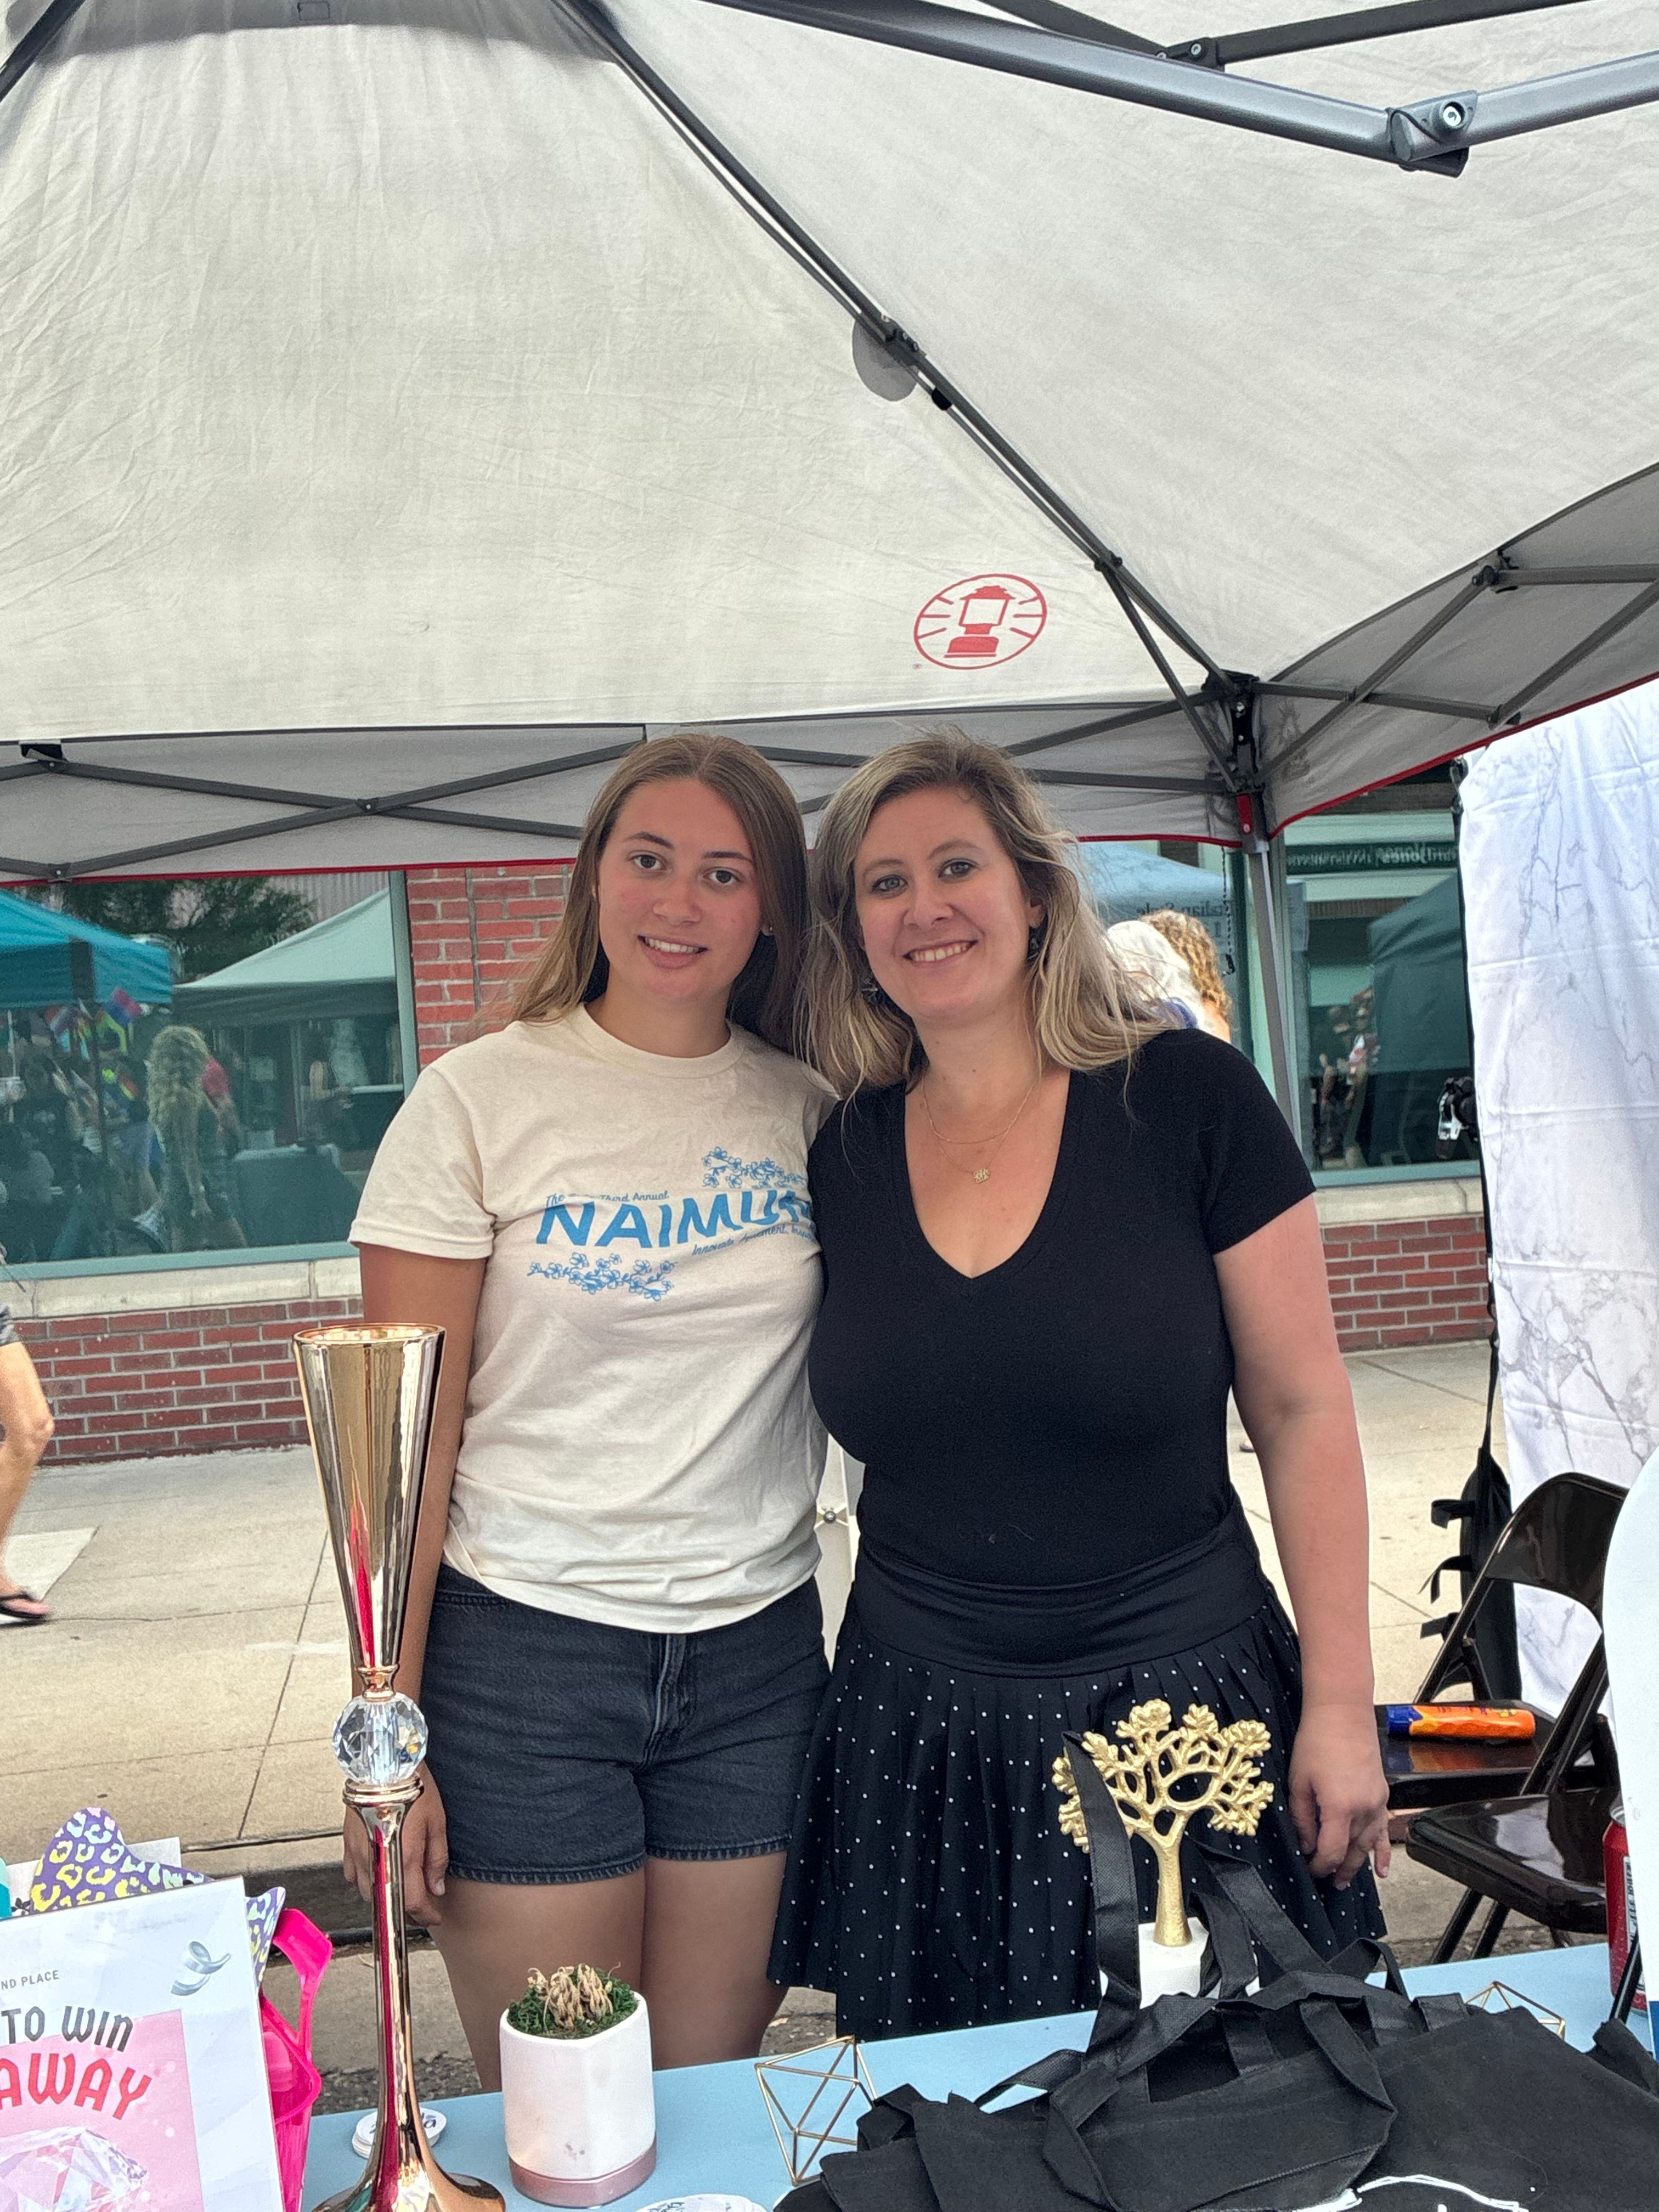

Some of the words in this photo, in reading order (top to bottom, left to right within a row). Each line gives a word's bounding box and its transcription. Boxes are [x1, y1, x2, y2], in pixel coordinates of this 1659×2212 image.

[546, 1193, 566, 1207] The
[632, 1189, 670, 1201] Annual
[21, 1970, 59, 1987] PLACE
[1, 2006, 45, 2044] TO
